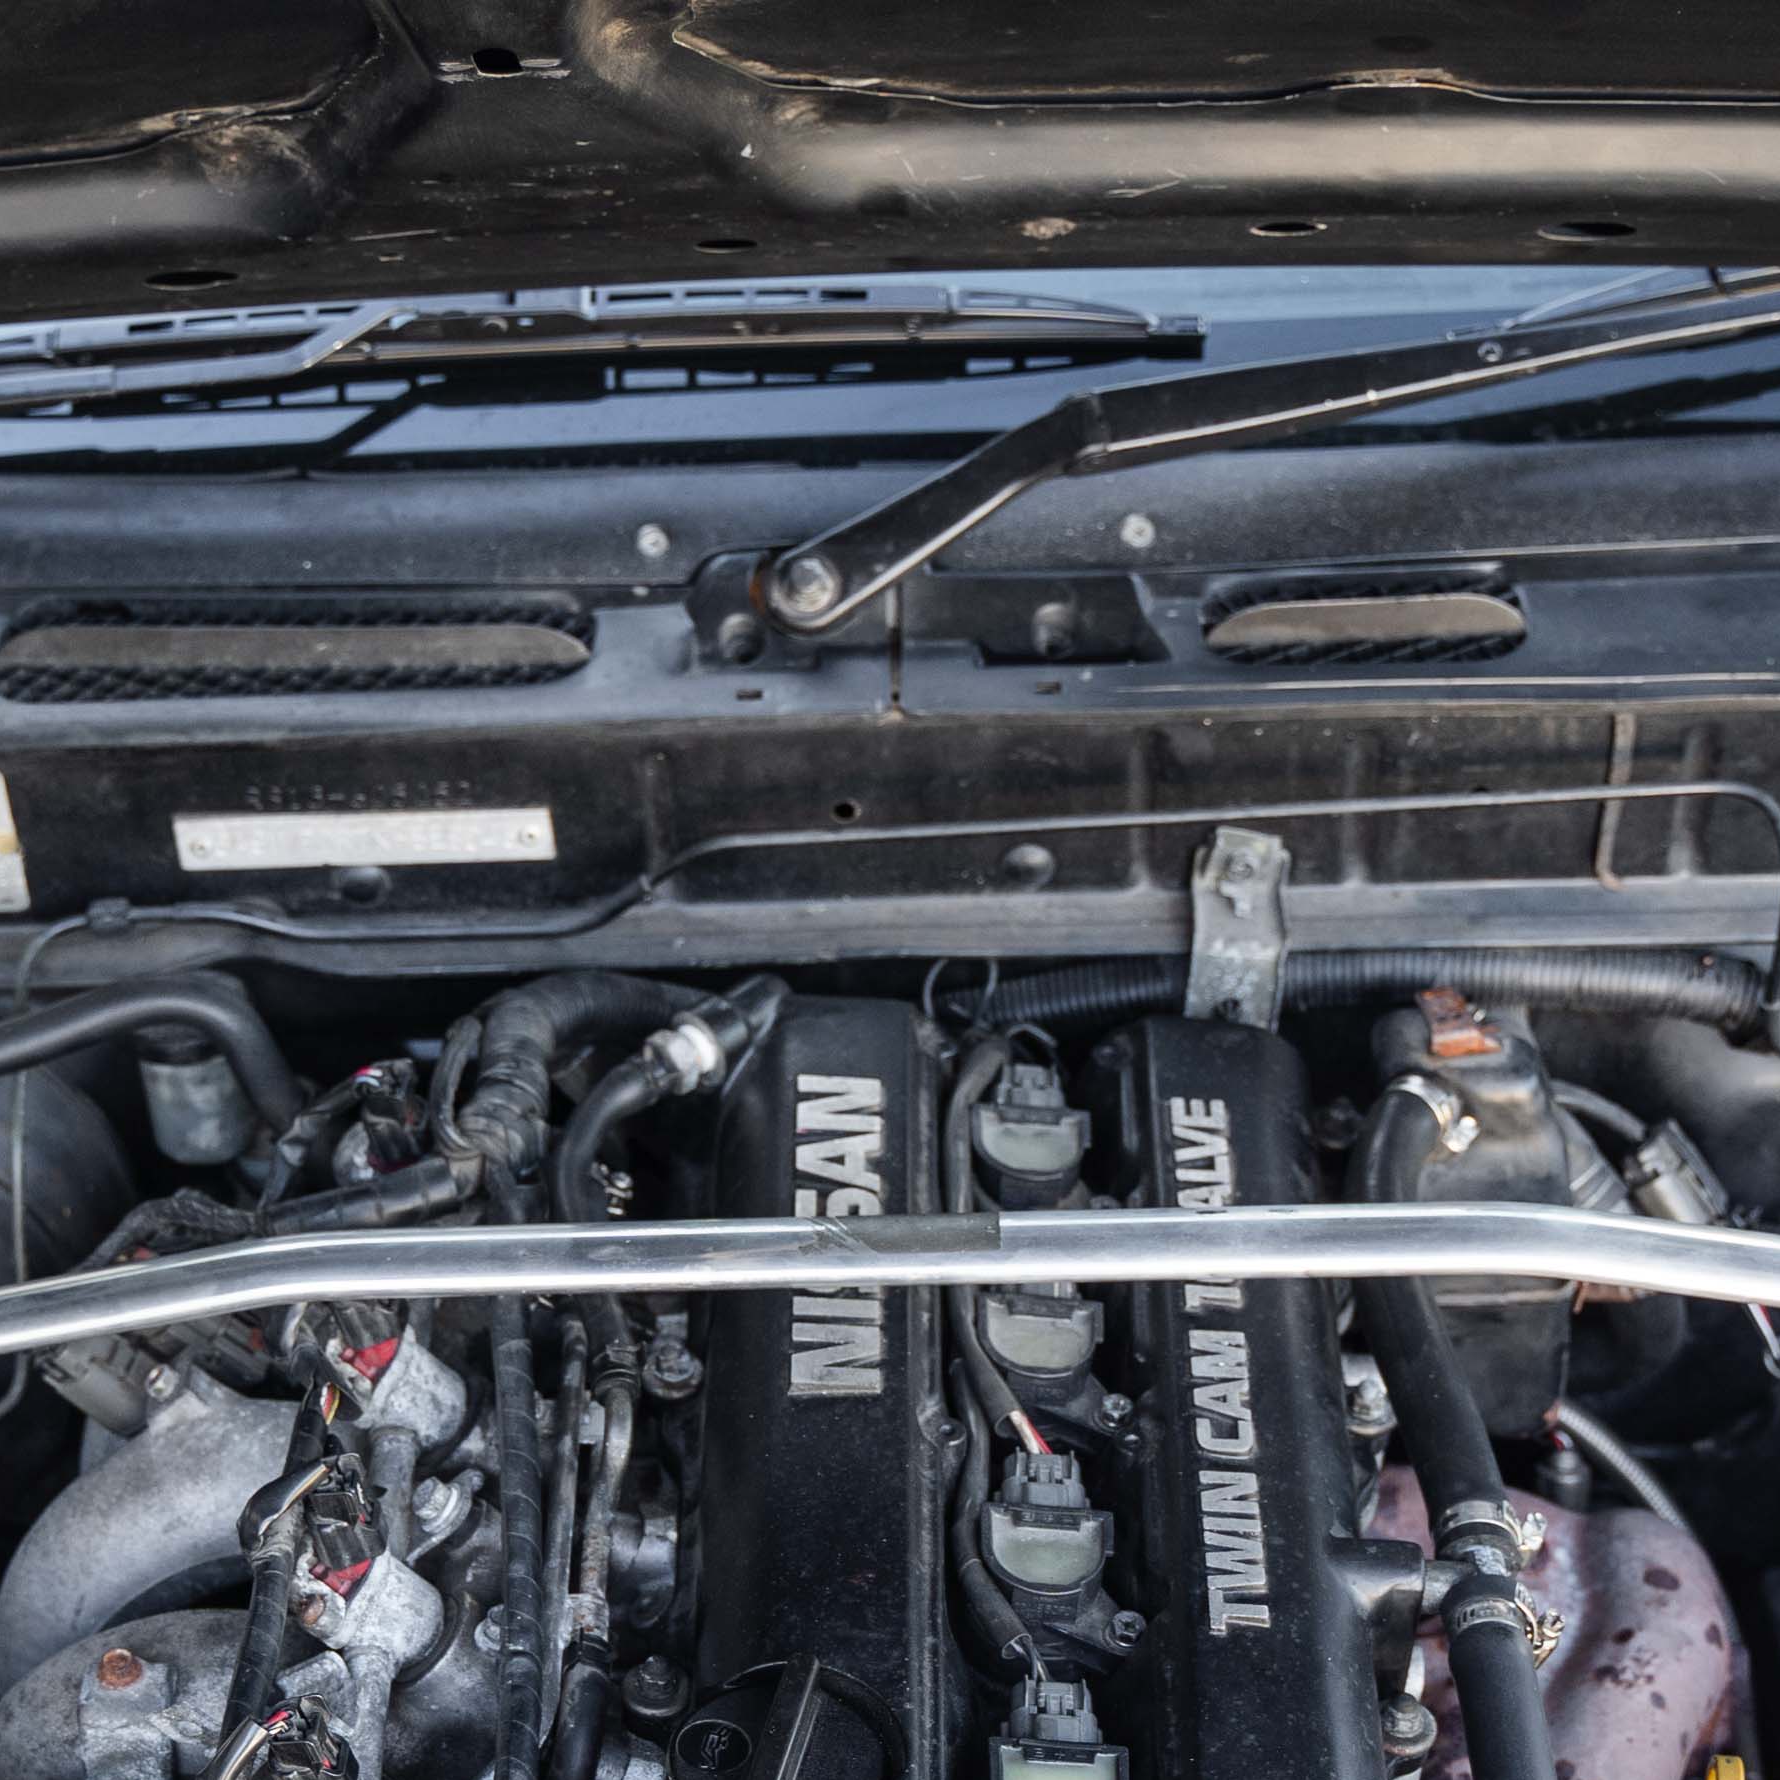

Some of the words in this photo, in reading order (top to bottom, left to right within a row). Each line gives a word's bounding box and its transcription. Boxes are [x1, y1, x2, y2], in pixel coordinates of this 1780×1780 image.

[1166, 1097, 1237, 1207] ALVE
[1188, 1328, 1258, 1459] CAM
[1202, 1470, 1271, 1634] TWIN
